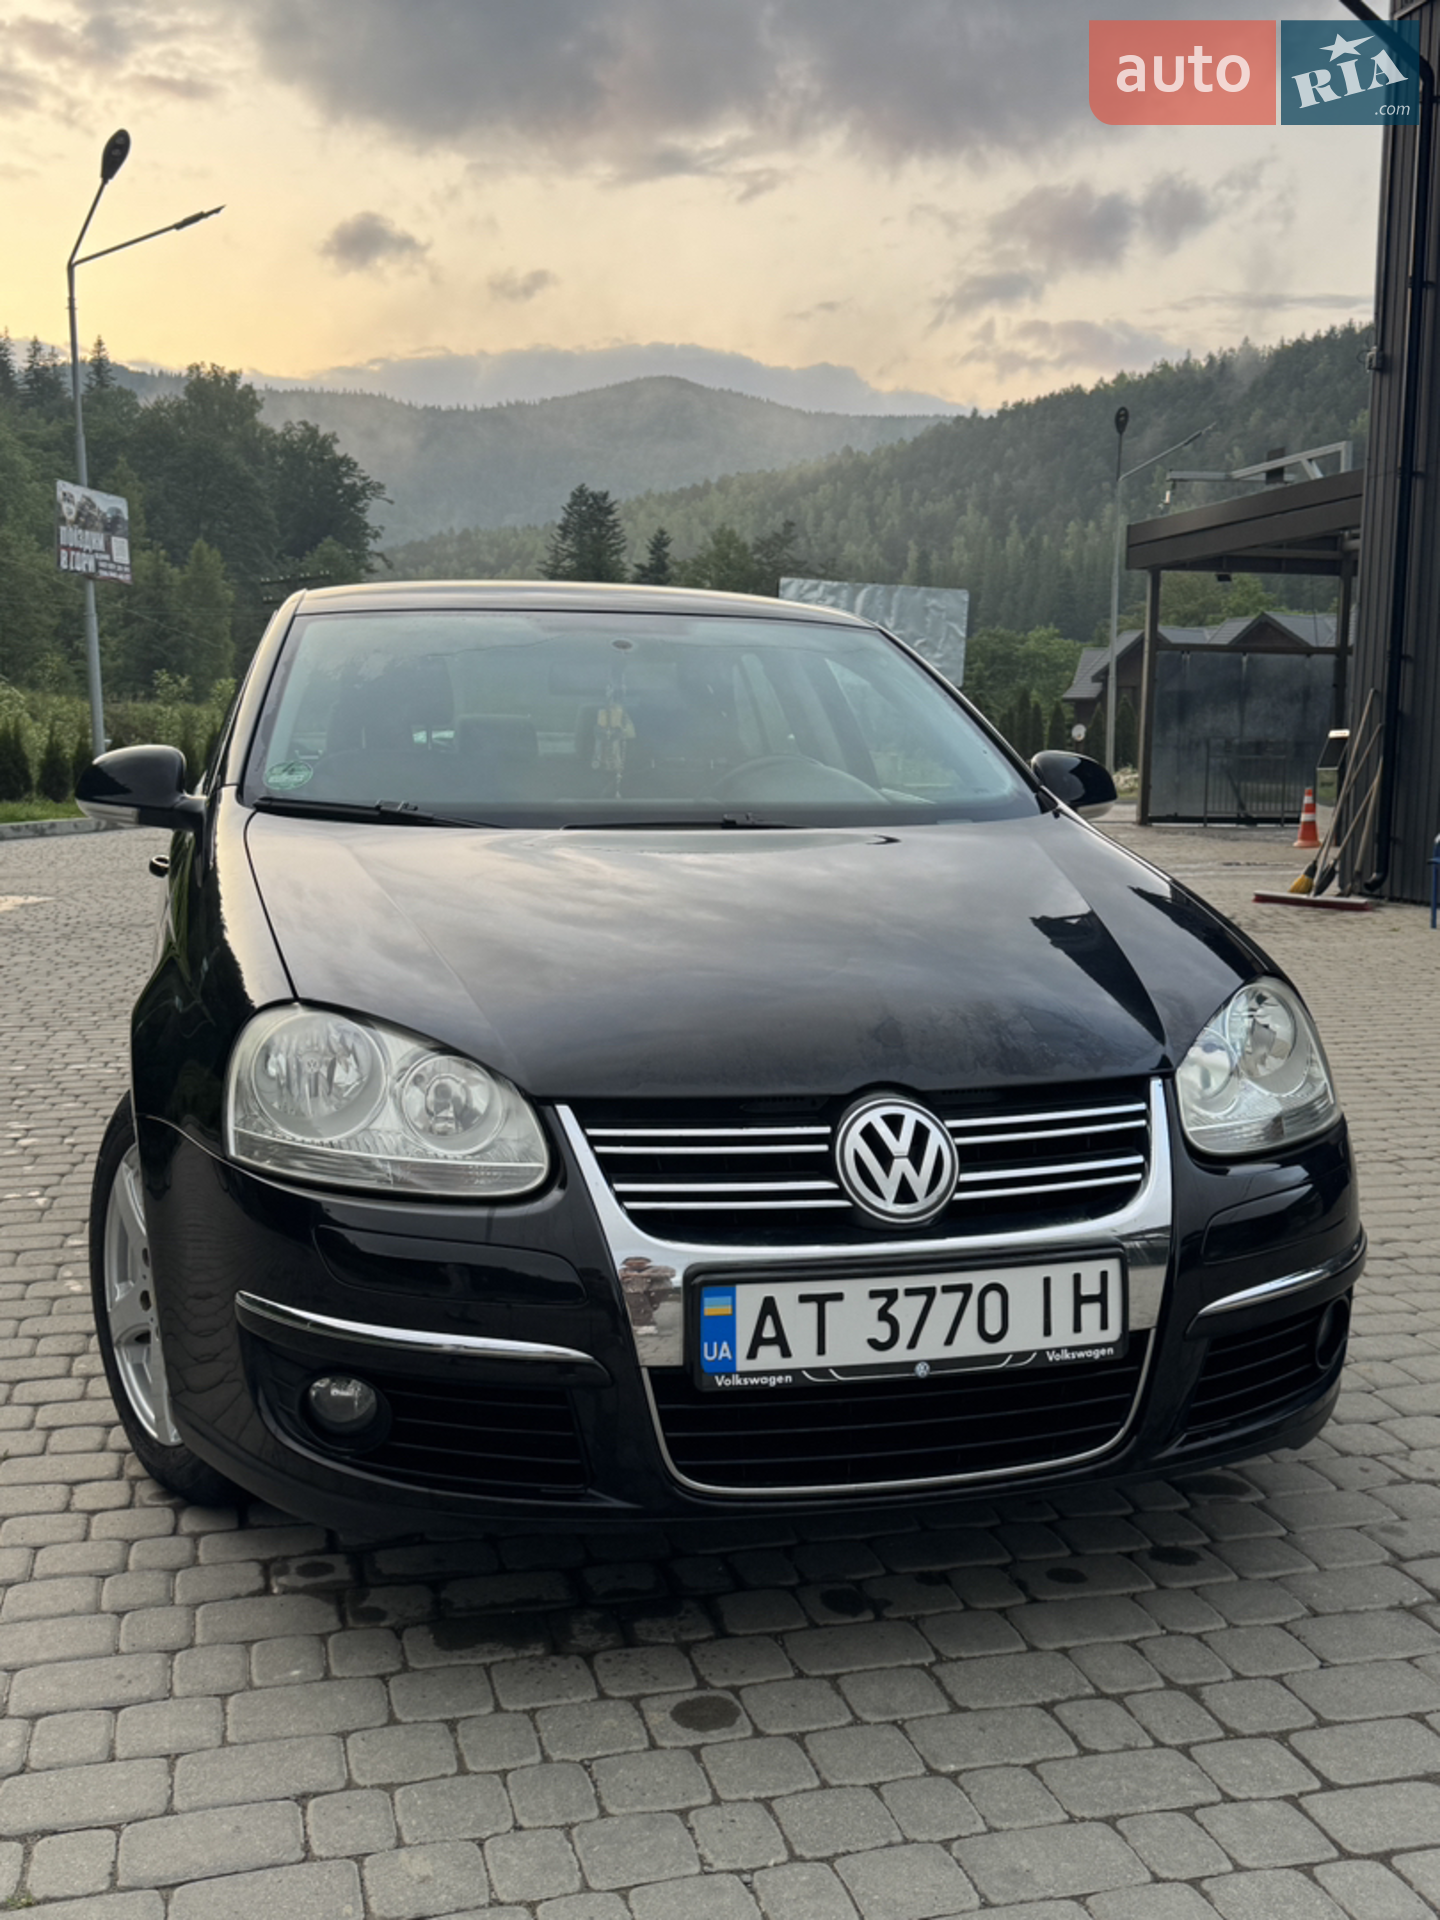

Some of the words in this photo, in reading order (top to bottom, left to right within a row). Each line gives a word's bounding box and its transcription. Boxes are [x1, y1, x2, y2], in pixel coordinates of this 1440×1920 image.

[746, 1292, 844, 1360] AT
[867, 1281, 1009, 1352] 3770
[1043, 1270, 1109, 1338] IH
[703, 1341, 733, 1361] UA
[1045, 1346, 1114, 1362] Volkswagen
[714, 1373, 793, 1387] Volkswagen
